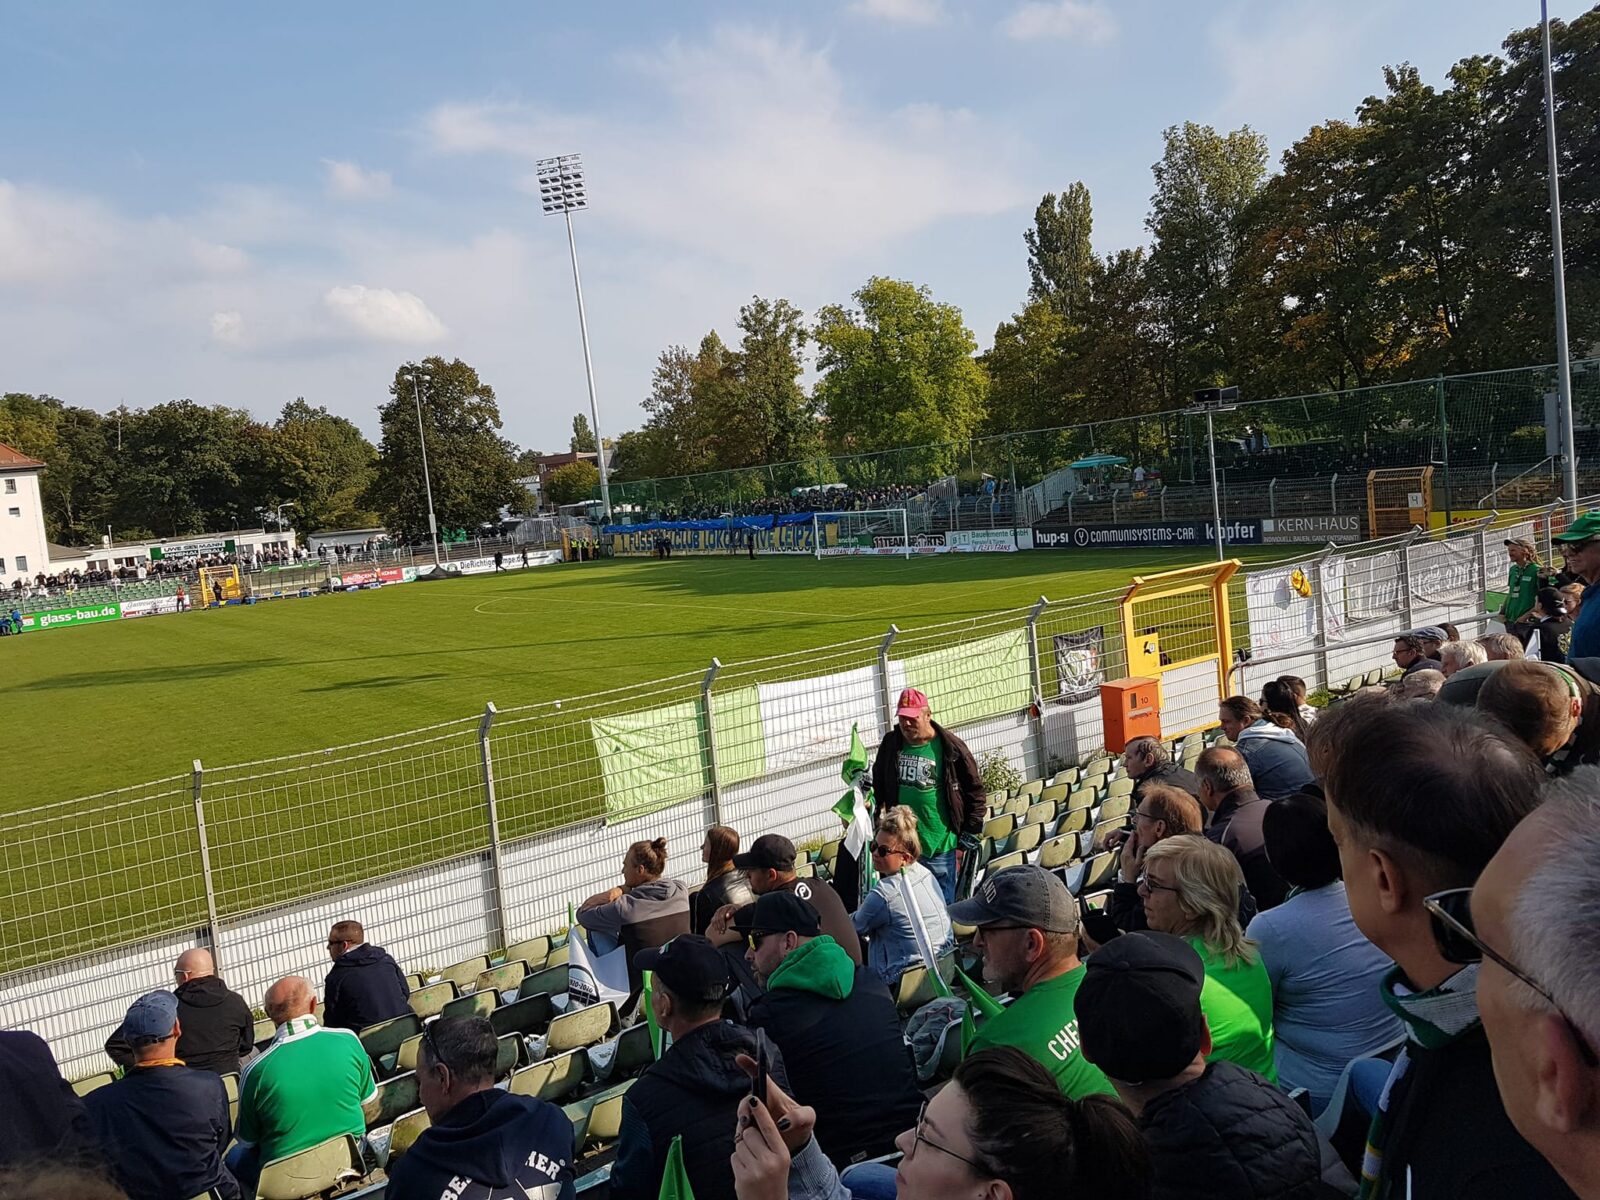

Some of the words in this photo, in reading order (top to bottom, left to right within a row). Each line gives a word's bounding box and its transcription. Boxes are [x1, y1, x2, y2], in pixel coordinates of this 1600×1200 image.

[1277, 516, 1359, 532] KERN-HAUS
[39, 606, 116, 627] glass-bau.de
[1141, 696, 1149, 705] 10
